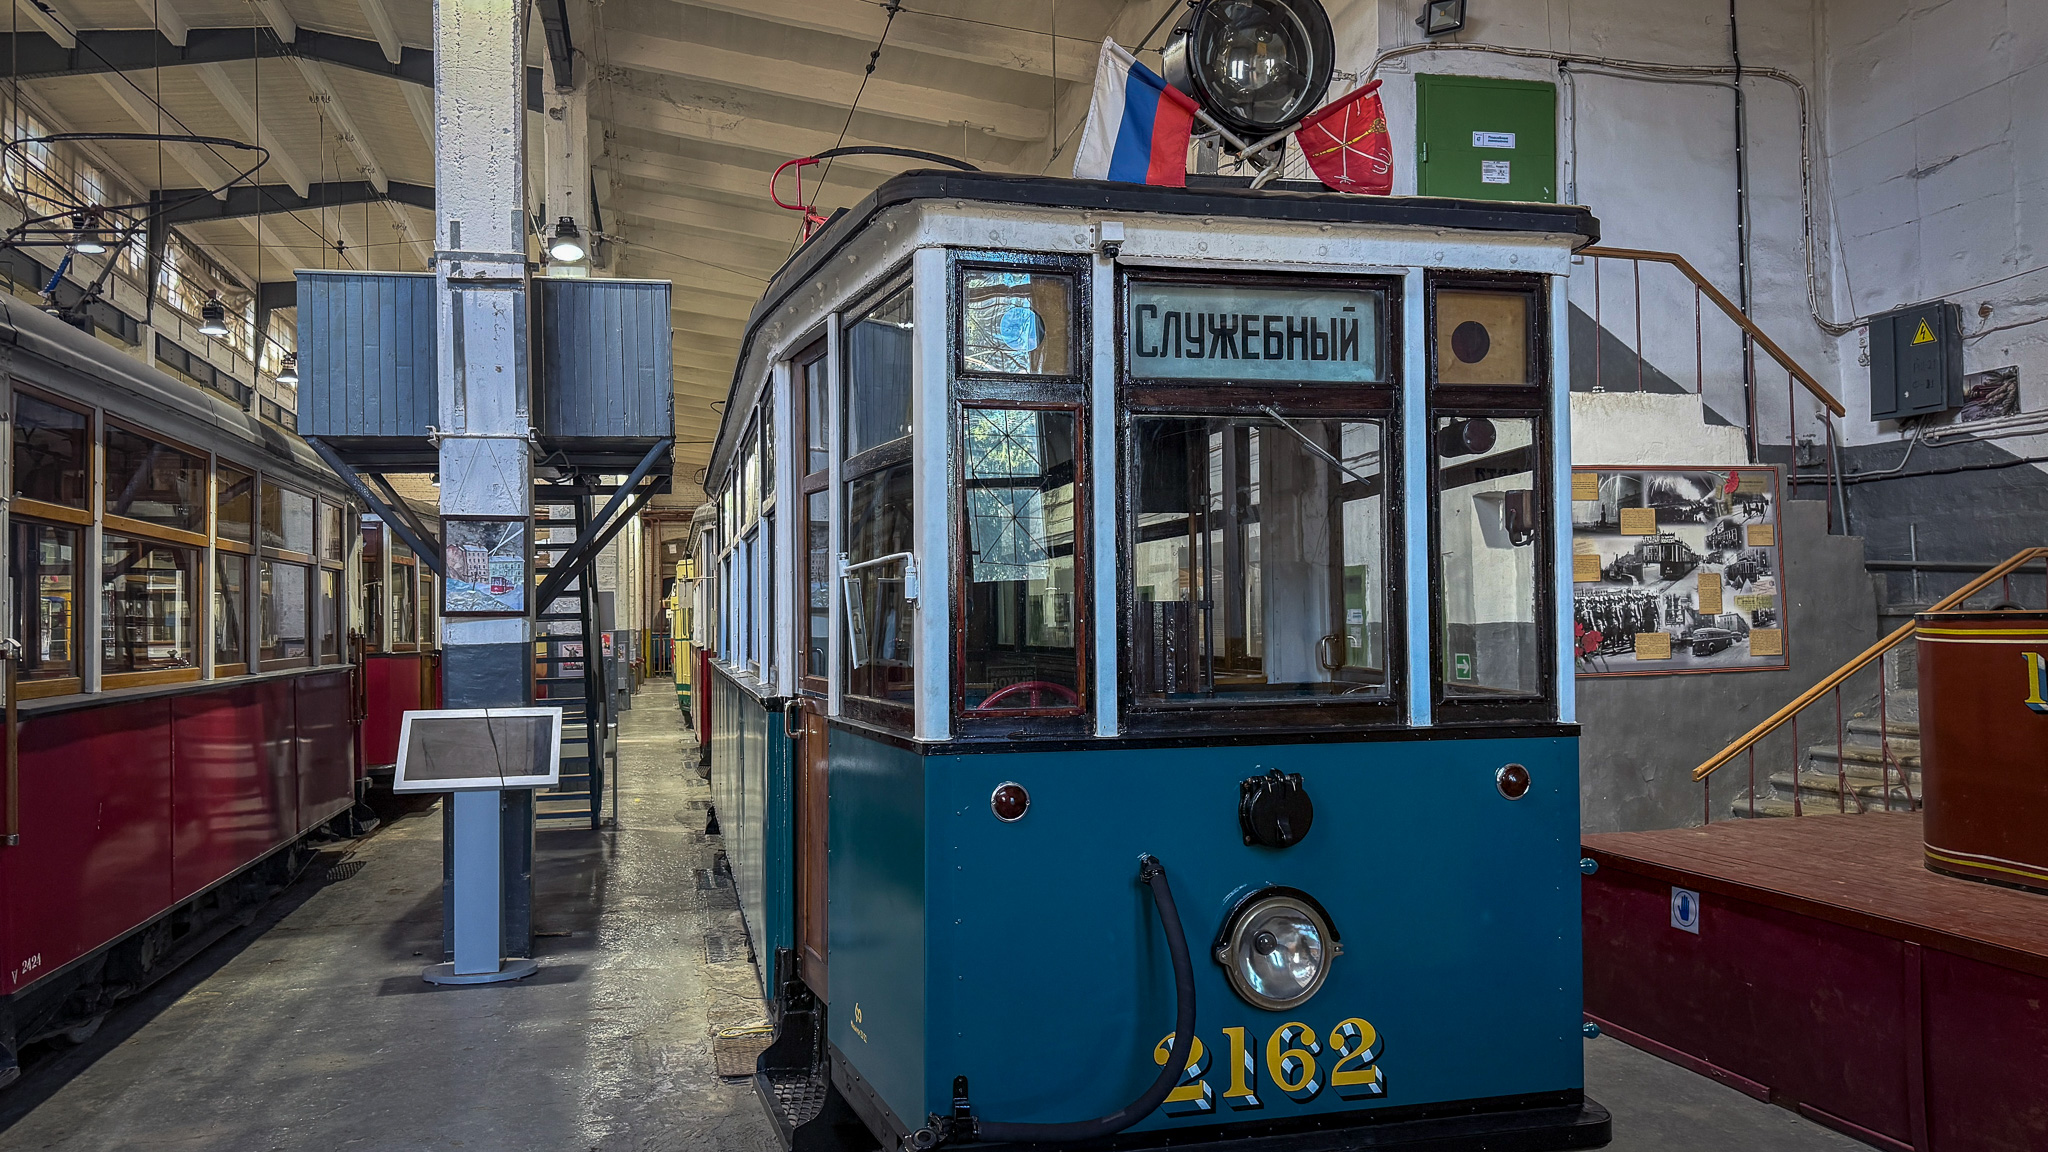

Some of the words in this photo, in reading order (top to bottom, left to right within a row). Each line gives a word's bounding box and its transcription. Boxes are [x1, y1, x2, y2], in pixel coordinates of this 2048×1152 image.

[1135, 304, 1359, 361] СЛУЖЕБНЫЙ
[22, 953, 41, 974] 2424
[1153, 1017, 1386, 1116] 2162
